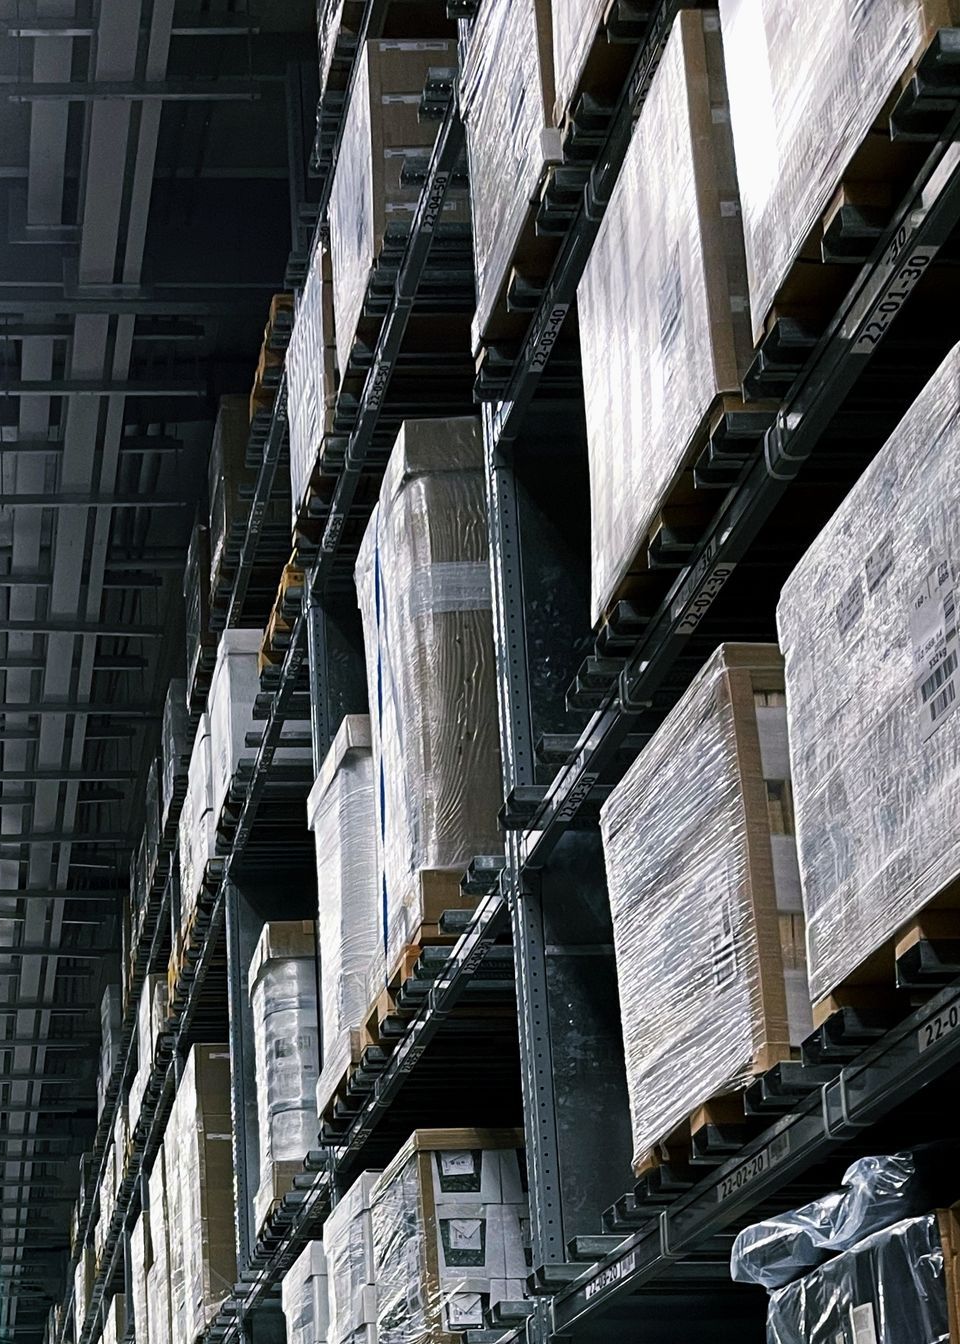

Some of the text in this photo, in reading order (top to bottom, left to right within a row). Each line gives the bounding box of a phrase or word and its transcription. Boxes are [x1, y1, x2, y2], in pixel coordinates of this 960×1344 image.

[858, 256, 930, 343] 22-01-30
[532, 310, 566, 366] 22-03-40
[680, 568, 731, 628] 22-02-30
[721, 1154, 764, 1198] 22-02-20
